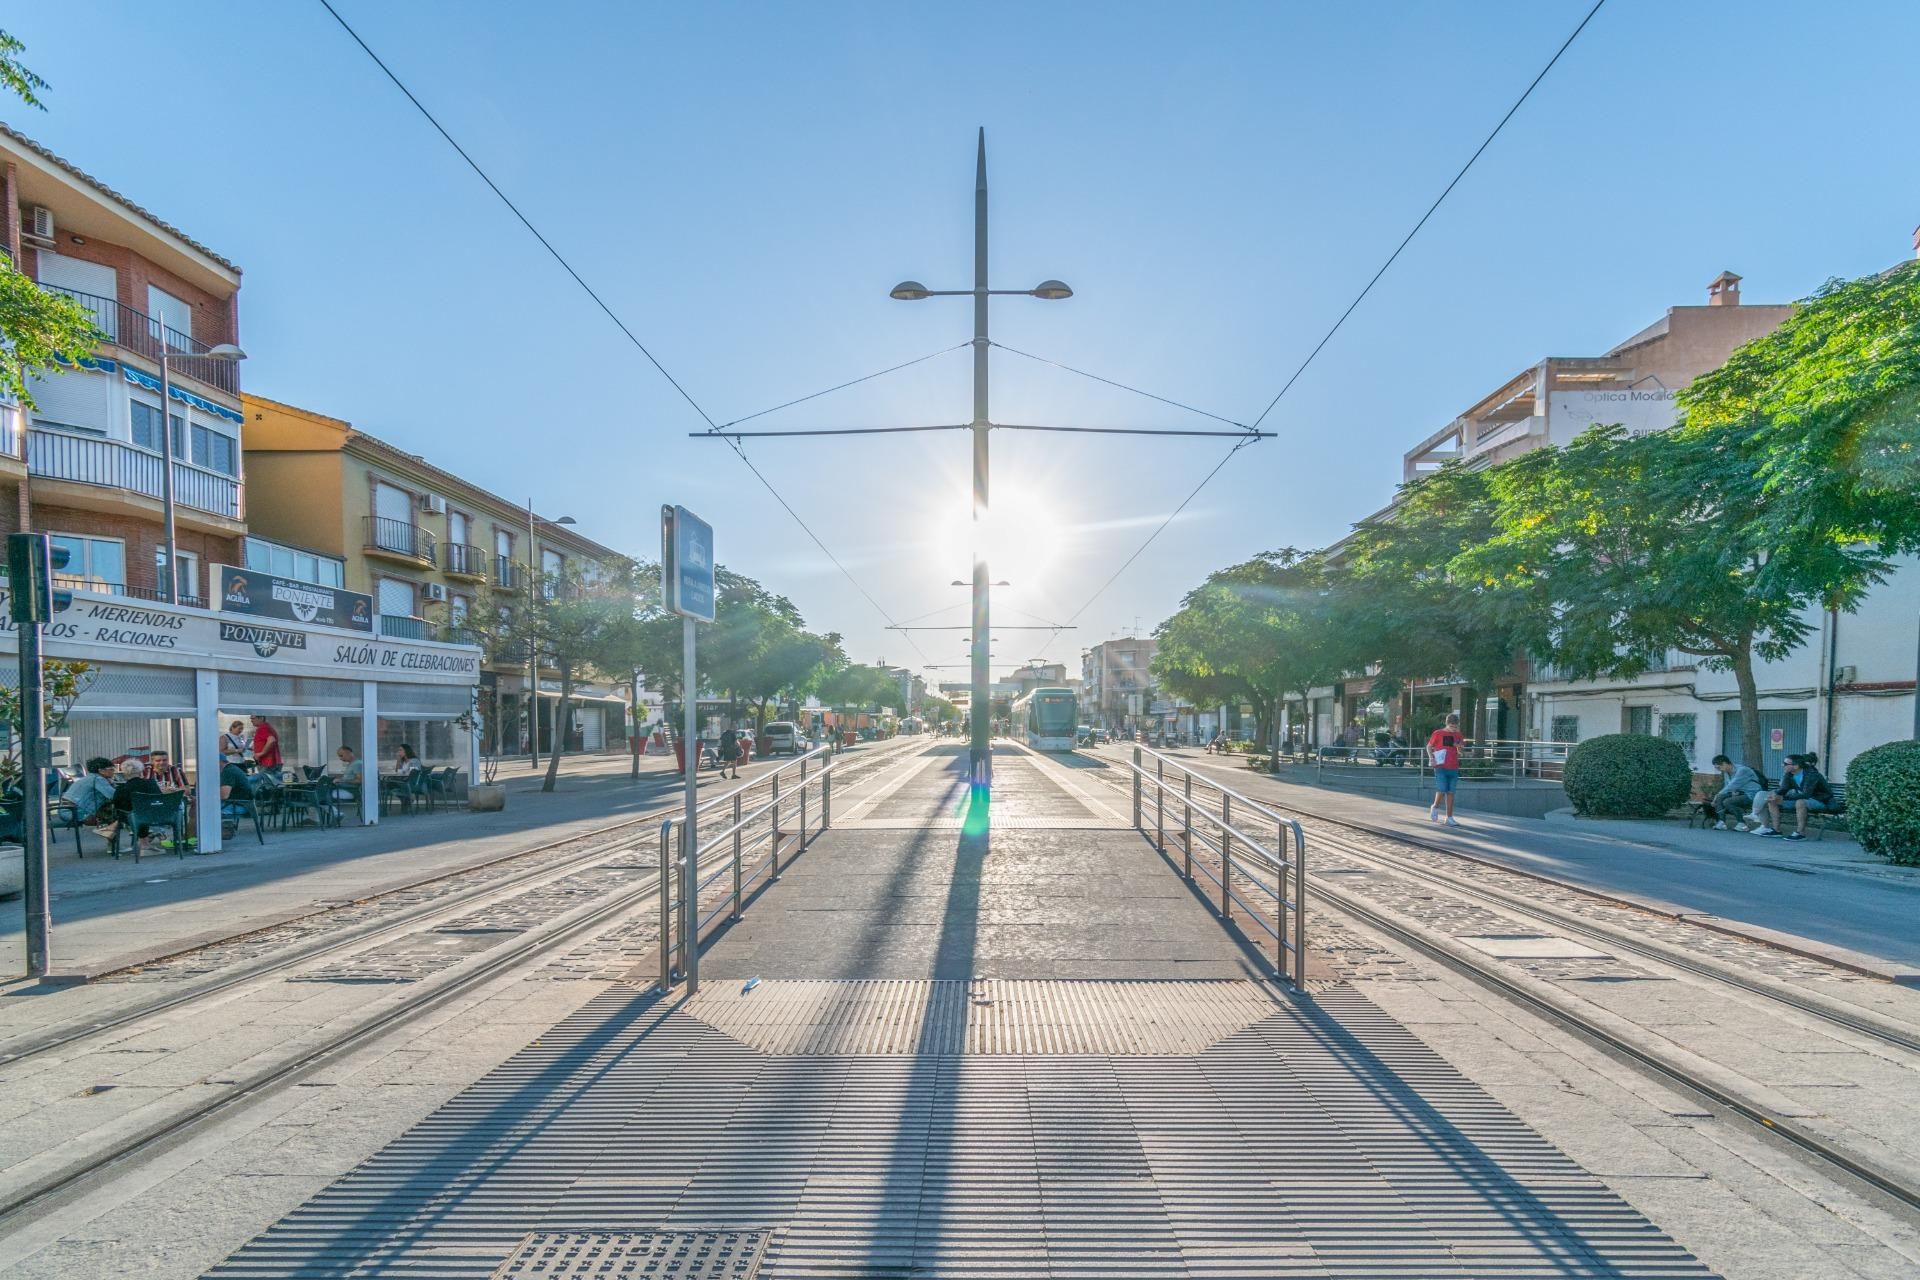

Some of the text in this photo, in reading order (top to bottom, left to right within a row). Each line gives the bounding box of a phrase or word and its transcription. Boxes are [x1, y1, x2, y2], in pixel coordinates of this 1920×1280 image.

[274, 587, 333, 608] PONIENTE
[88, 605, 186, 630] MERIENDAS
[95, 627, 179, 648] RACIONES
[223, 625, 303, 648] PONIENTE
[333, 643, 476, 673] SALÓN DE CELEBRACIONES
